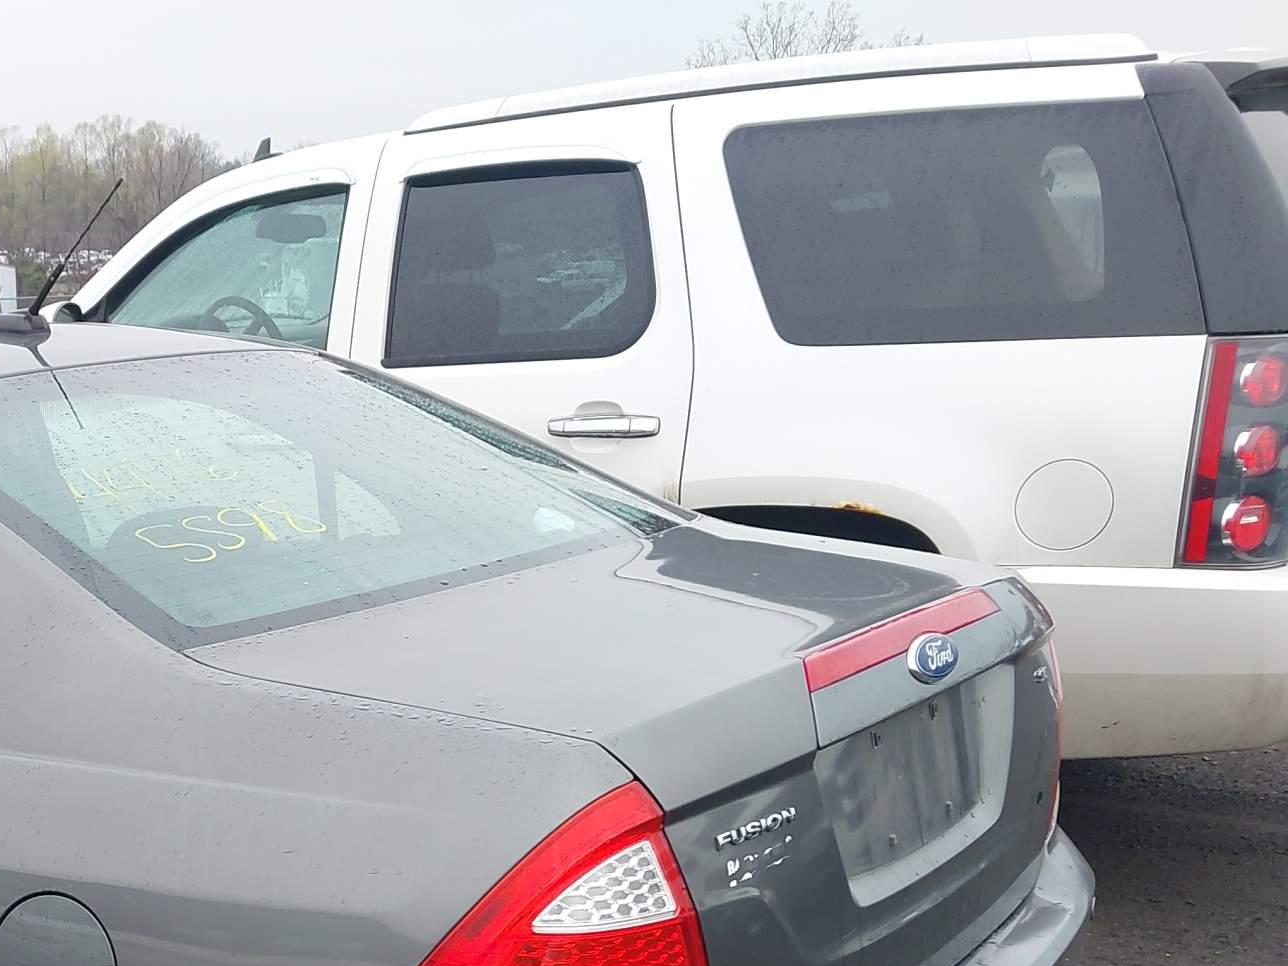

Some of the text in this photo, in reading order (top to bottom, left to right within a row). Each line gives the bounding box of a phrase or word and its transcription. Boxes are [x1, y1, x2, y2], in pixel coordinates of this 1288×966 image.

[134, 498, 329, 564] 5598
[924, 639, 955, 671] Ford
[715, 806, 797, 852] FUSION
